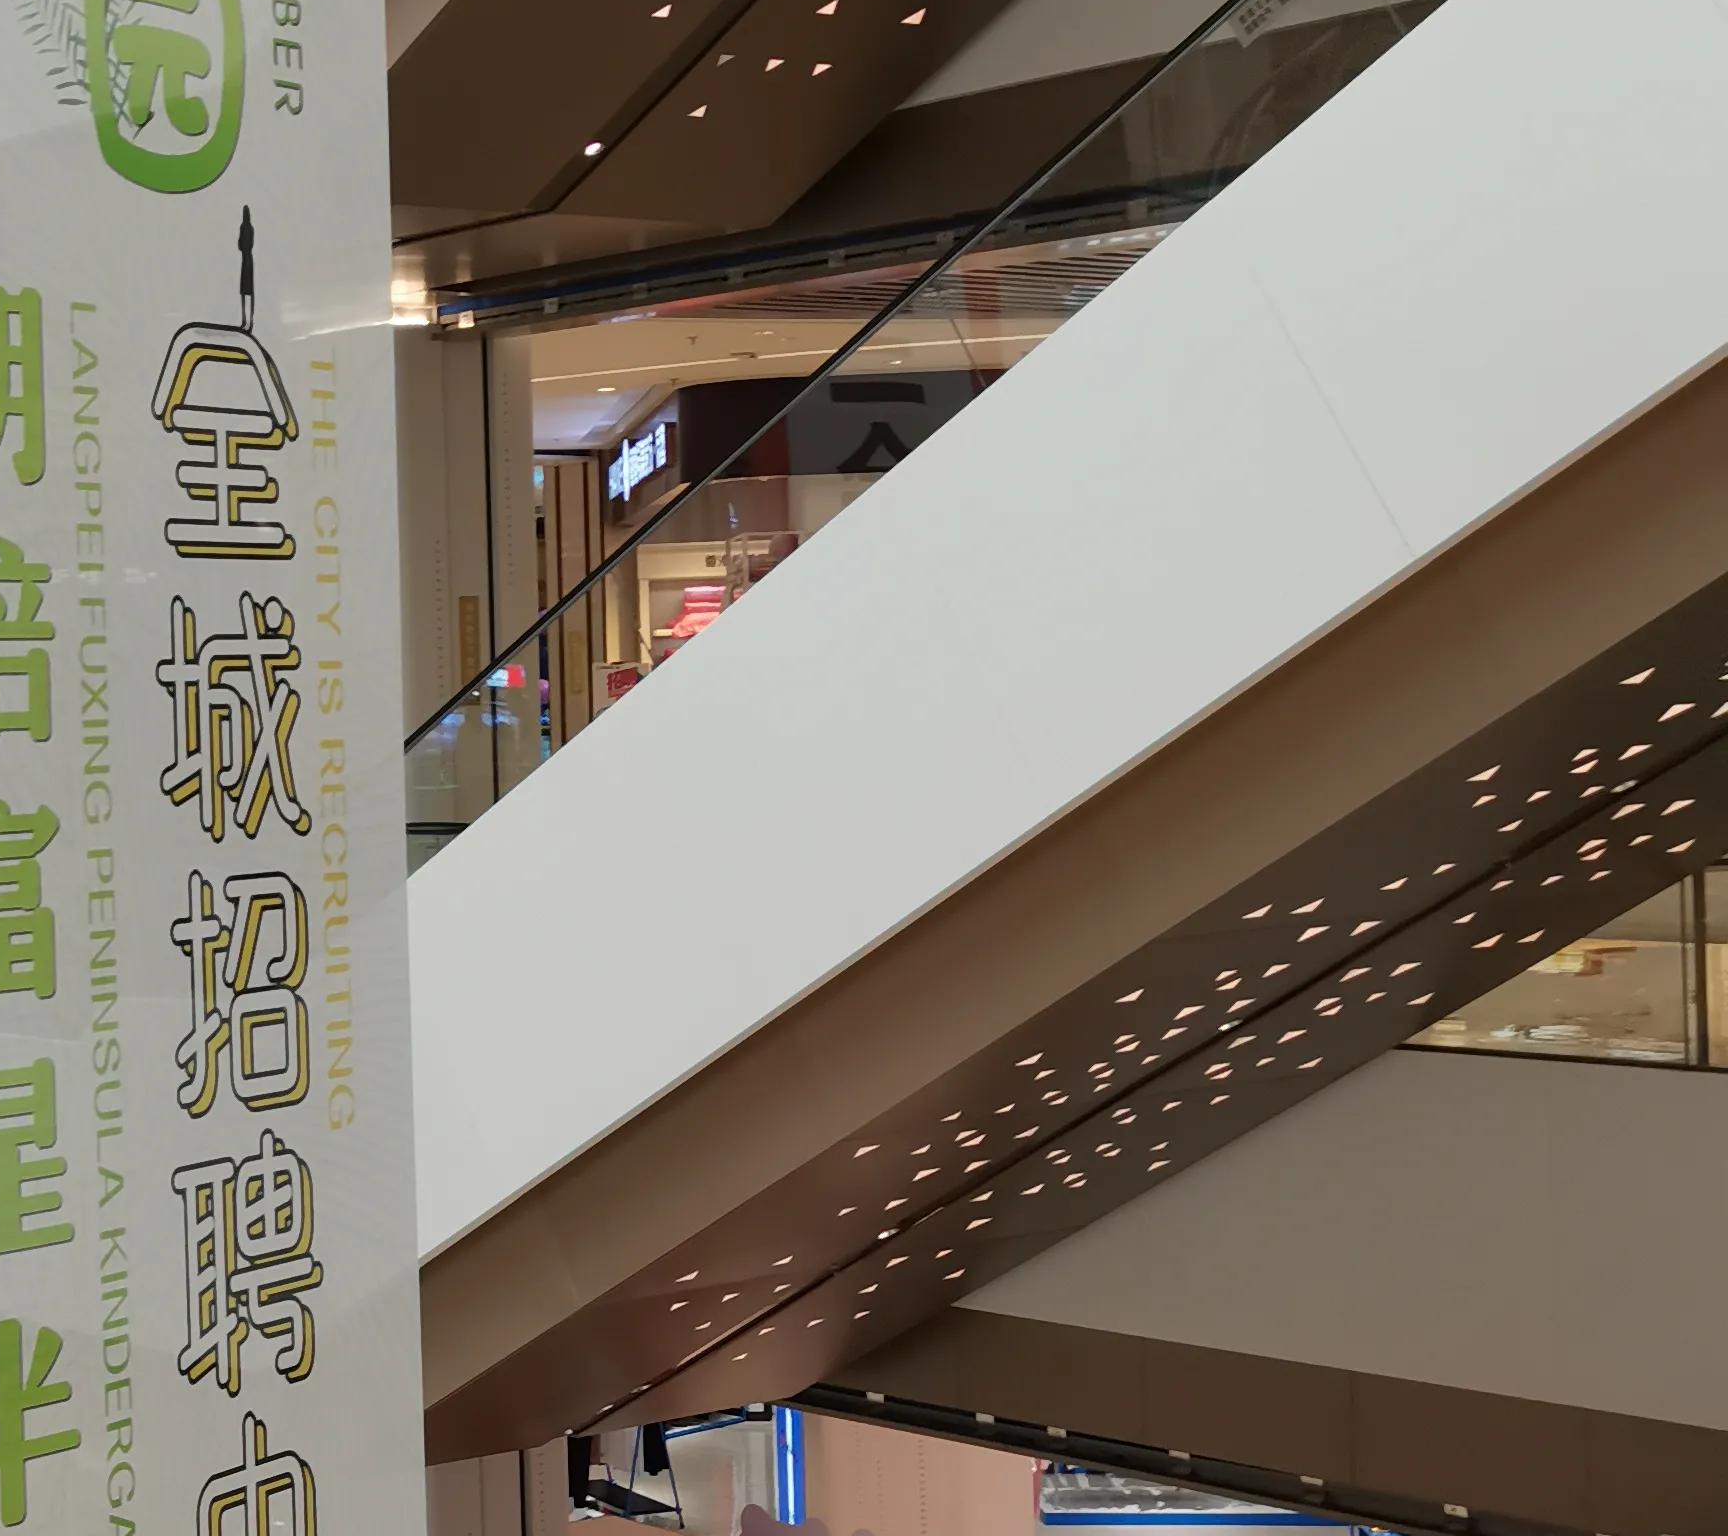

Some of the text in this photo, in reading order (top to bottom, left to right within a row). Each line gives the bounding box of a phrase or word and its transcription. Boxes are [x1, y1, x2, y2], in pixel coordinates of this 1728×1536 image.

[69, 300, 106, 574] LANGPEI
[77, 597, 113, 827] FUXING
[309, 357, 355, 1132] THE CITY IS RECRUITING
[86, 847, 125, 1209] PENINSULA
